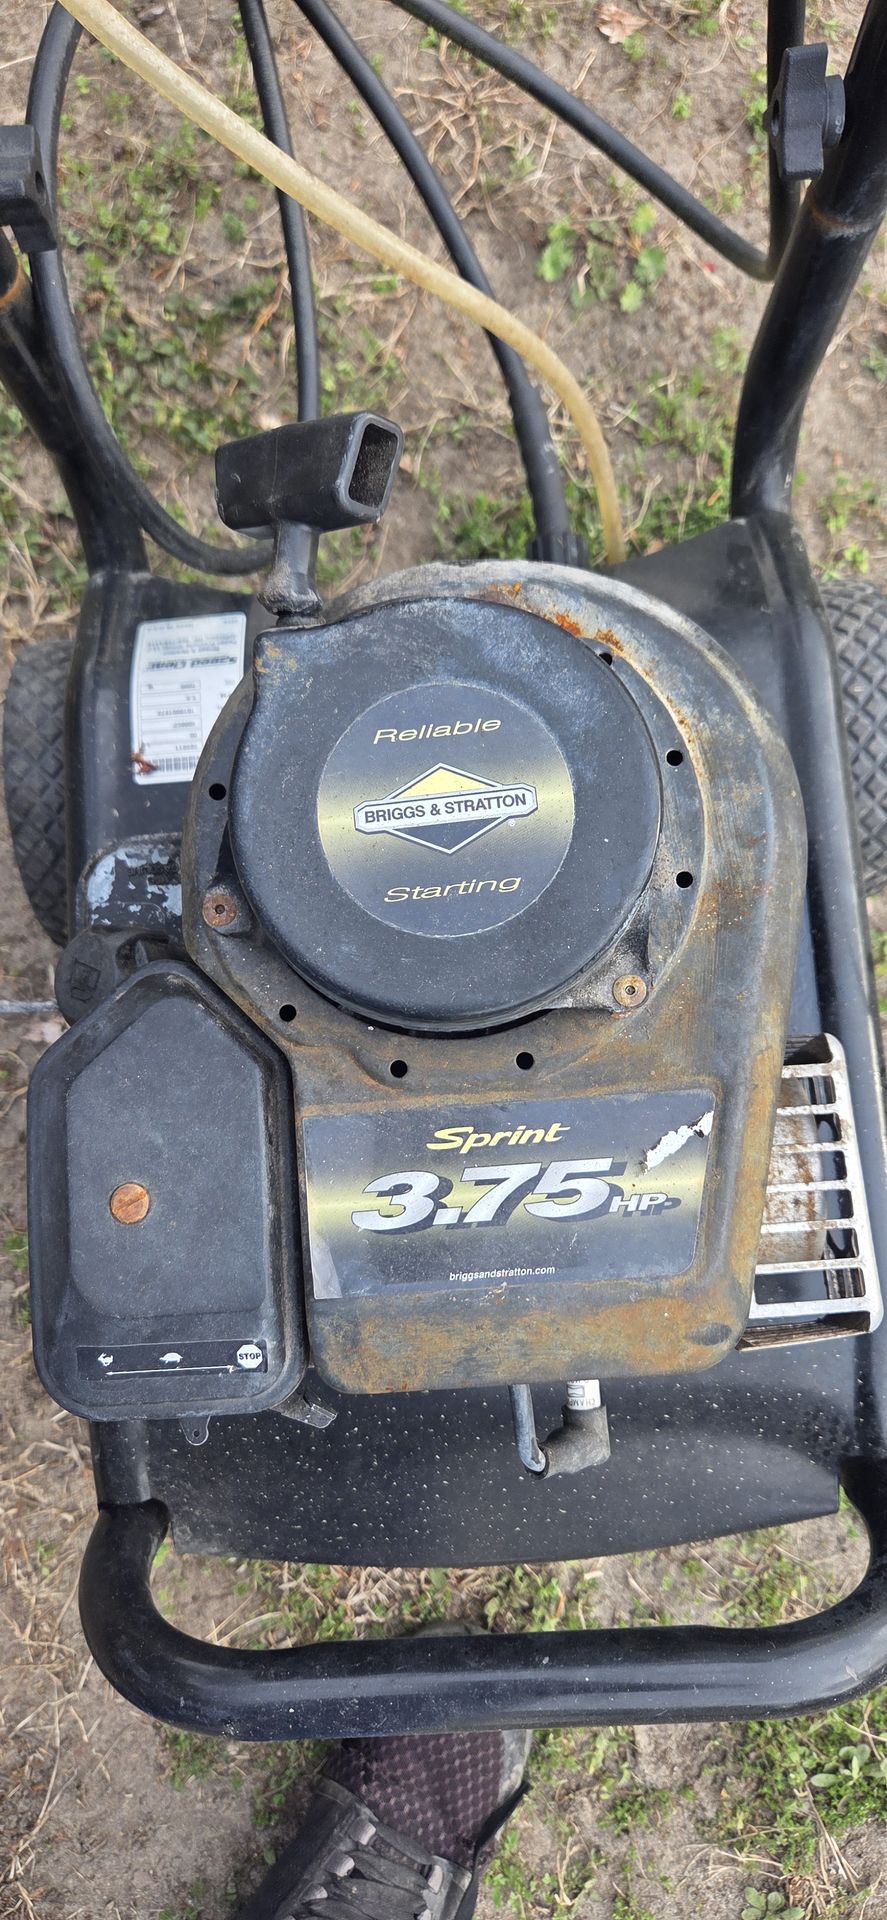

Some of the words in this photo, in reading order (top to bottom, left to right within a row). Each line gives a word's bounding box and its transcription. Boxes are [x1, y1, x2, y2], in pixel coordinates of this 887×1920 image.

[373, 718, 502, 744] Reliable
[364, 805, 426, 824] BRIGGS
[430, 803, 441, 816] &
[444, 793, 527, 815] STRATTON
[384, 877, 522, 903] Starting
[426, 1123, 571, 1154] Sprint
[351, 1157, 616, 1231] 3.75
[608, 1194, 669, 1213] HP
[449, 1265, 556, 1281] briggsandstratton.com
[239, 1352, 261, 1360] STOP
